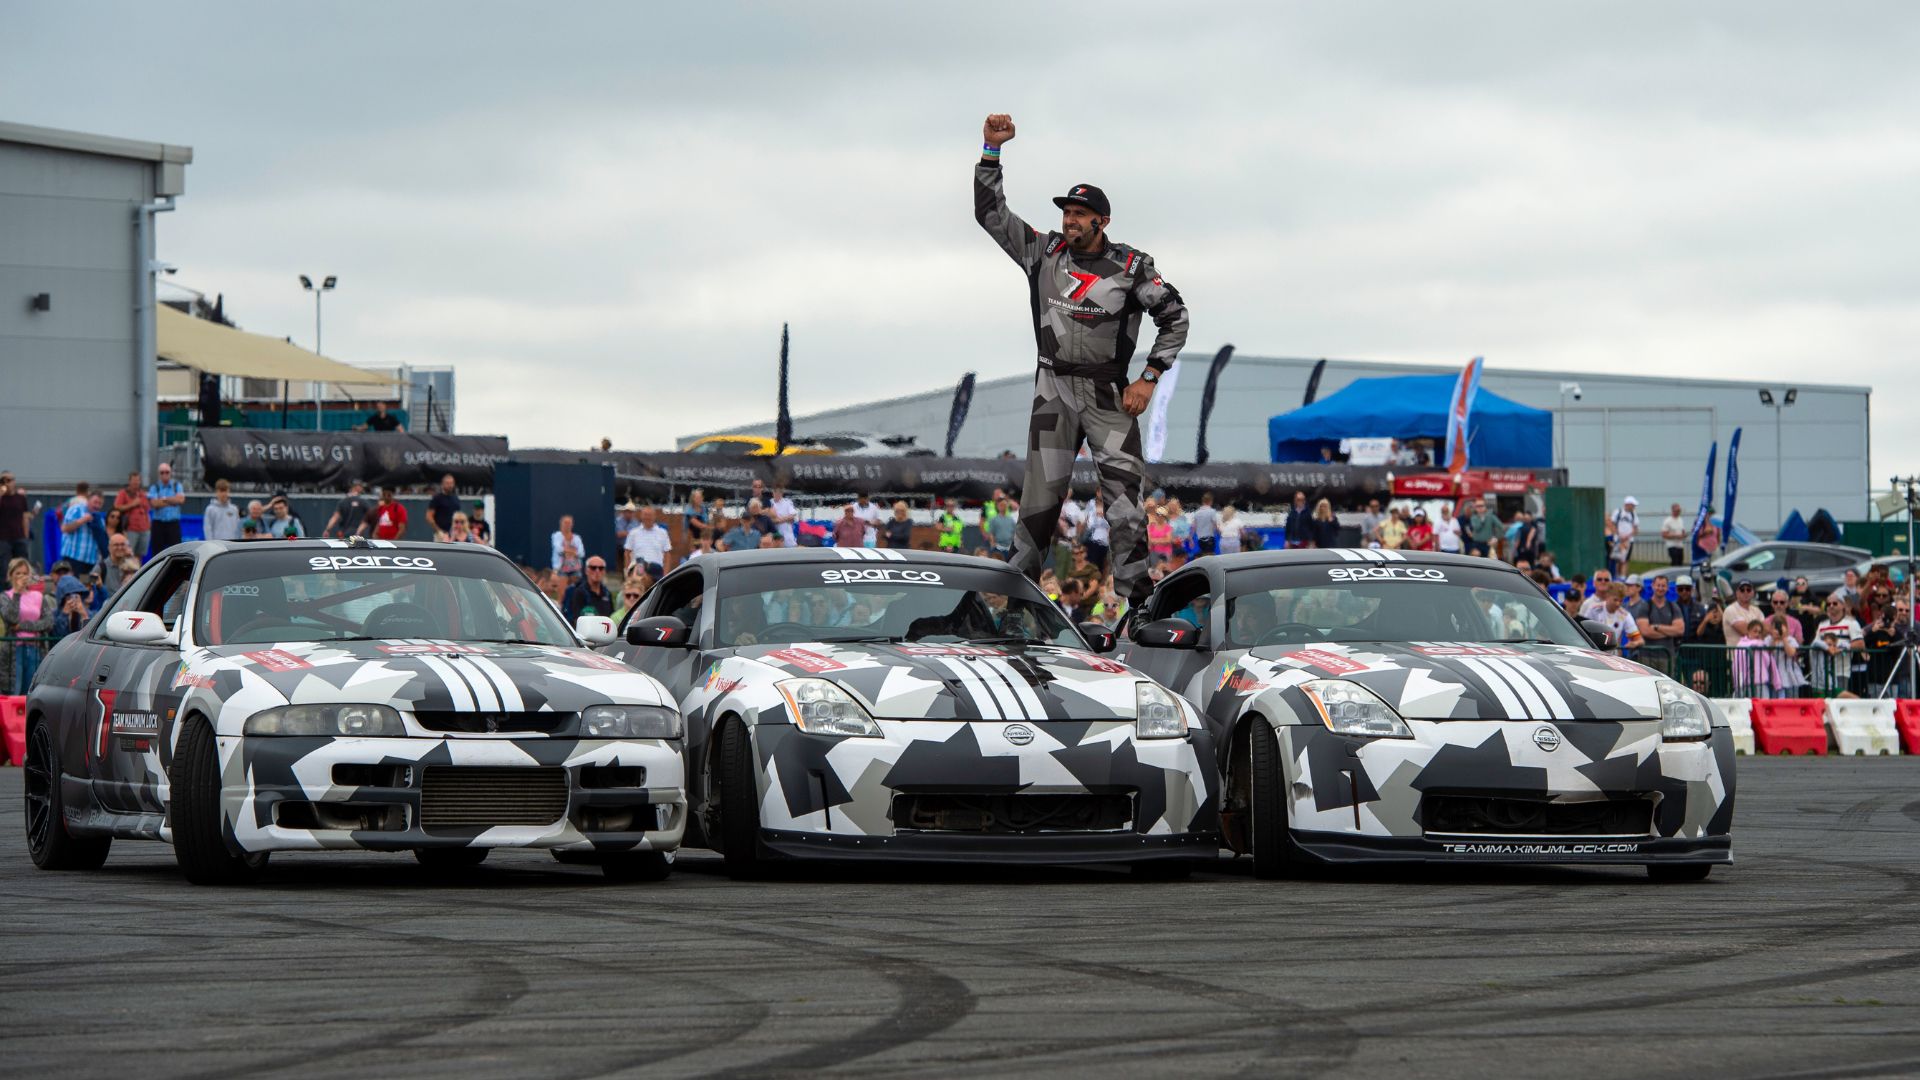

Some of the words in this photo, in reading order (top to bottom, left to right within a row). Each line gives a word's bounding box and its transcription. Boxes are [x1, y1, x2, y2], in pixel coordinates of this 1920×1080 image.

[1048, 297, 1062, 306] TEAM
[244, 443, 324, 461] PREMIER
[331, 444, 353, 462] GT
[404, 451, 462, 466] SUPERCAR
[309, 556, 437, 571] sparco
[821, 568, 944, 586] sparco
[1328, 566, 1448, 582] sparco
[1298, 650, 1359, 670] CHAMPION
[113, 713, 124, 727] TEAM
[125, 713, 145, 728] MAXIMUM
[146, 714, 158, 728] LOCK
[1443, 844, 1638, 853] TEAMMAXIMUMLOCK.COM
